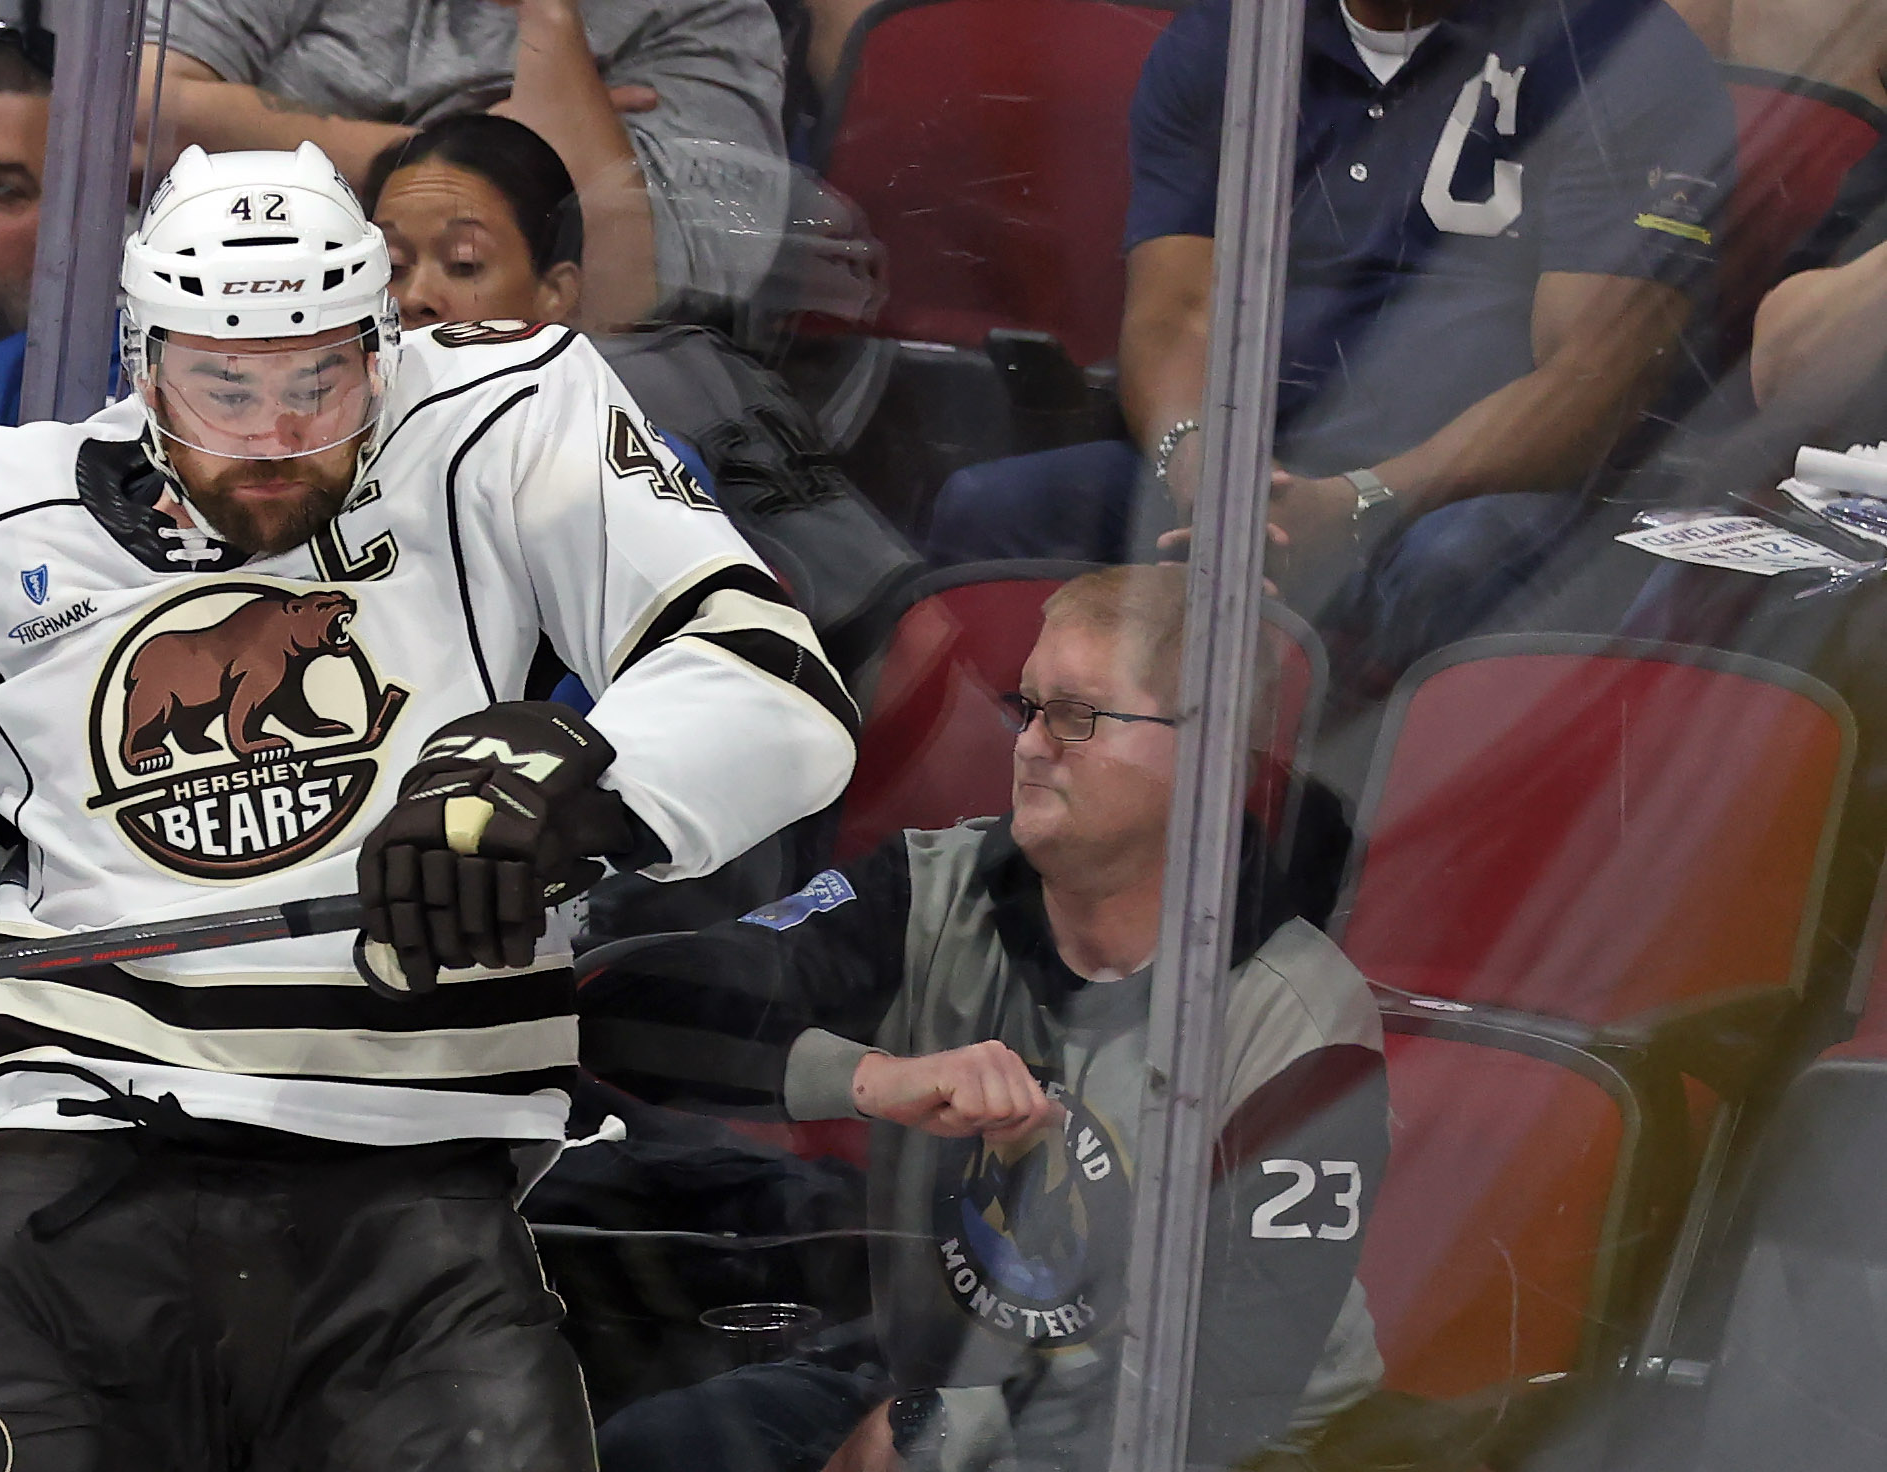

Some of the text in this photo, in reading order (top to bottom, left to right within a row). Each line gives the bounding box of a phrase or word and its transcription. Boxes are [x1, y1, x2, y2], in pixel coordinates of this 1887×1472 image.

[226, 192, 289, 223] 42
[221, 279, 306, 296] CCM
[16, 597, 93, 645] HIGHMARK
[173, 760, 308, 801] HERSHEY
[157, 779, 333, 856] BEARS
[1251, 1159, 1362, 1241] 23
[940, 1237, 1096, 1339] MONSTERS
